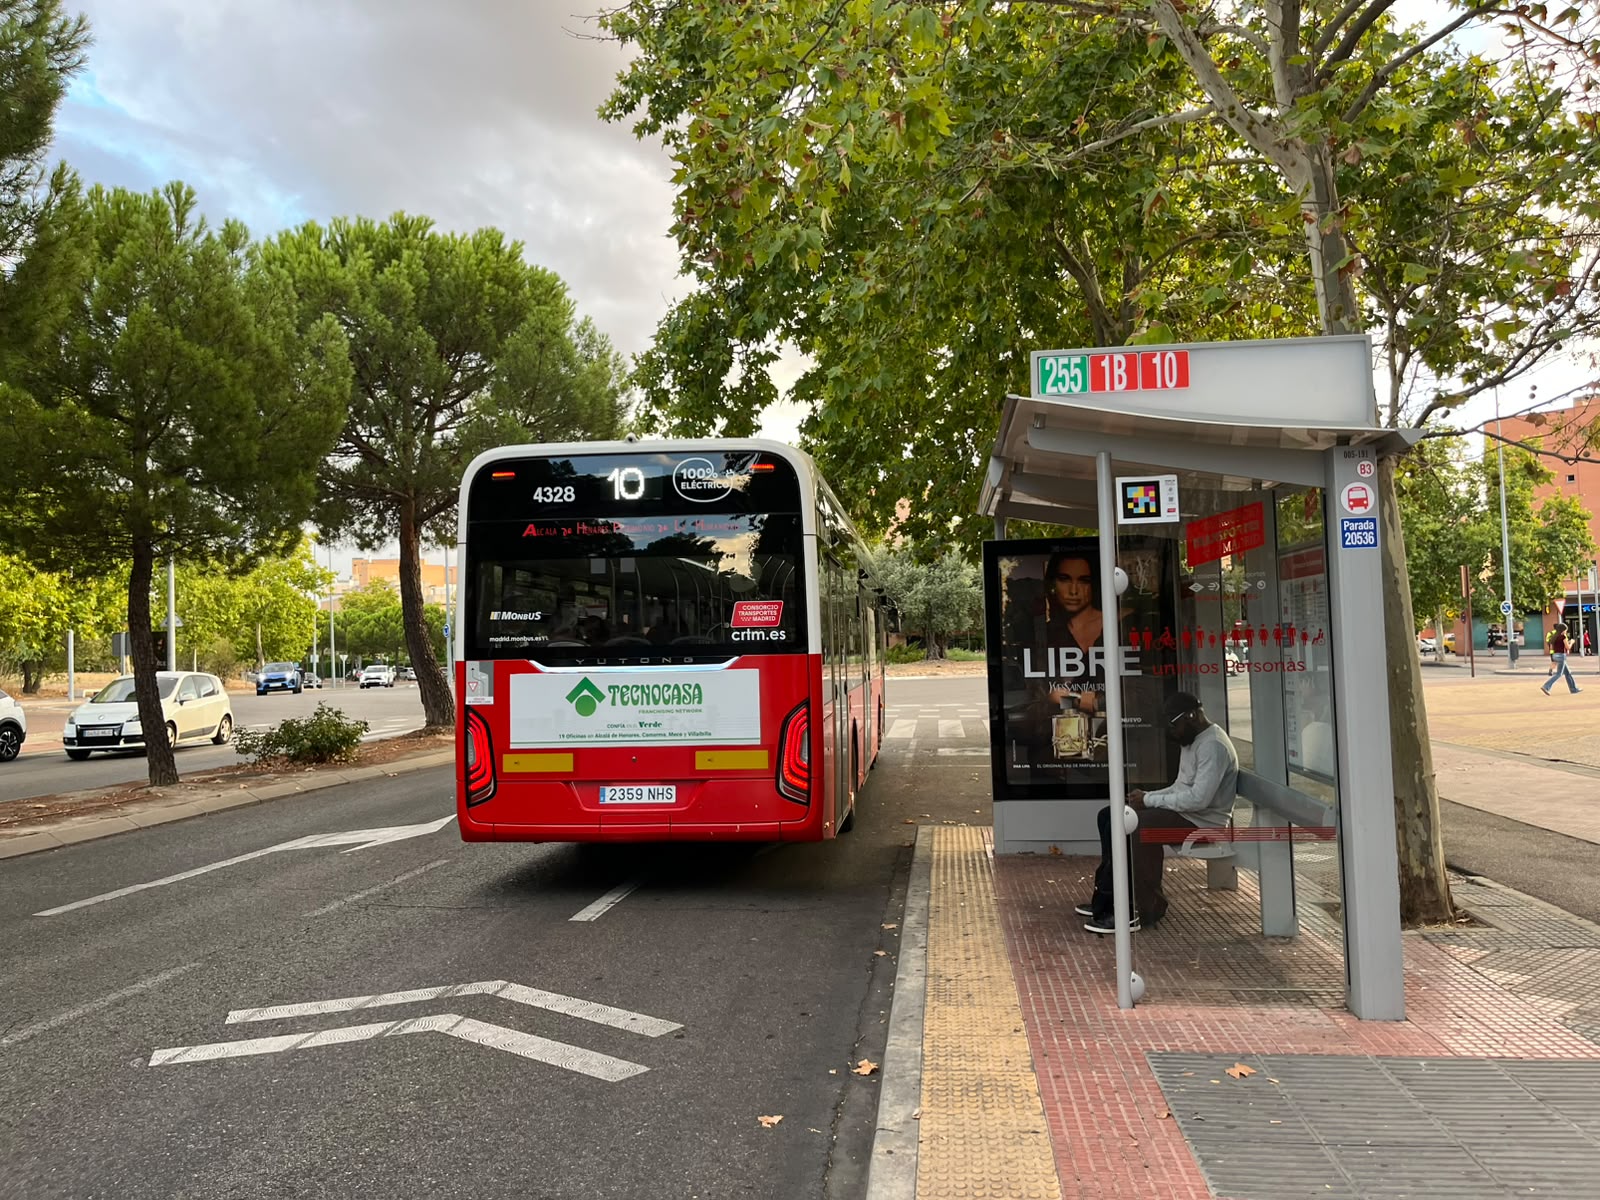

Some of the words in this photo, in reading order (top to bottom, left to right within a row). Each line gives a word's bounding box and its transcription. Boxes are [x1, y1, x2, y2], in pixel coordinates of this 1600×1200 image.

[1045, 357, 1082, 394] 255
[1101, 354, 1127, 391] 1B
[1152, 352, 1178, 388] 10
[681, 467, 718, 480] 100%
[1360, 463, 1372, 475] B3
[606, 467, 645, 500] 10
[681, 478, 729, 490] ELÉCTRICO
[533, 486, 576, 503] 4328
[1344, 520, 1375, 531] Parada
[1345, 531, 1375, 546] 20536
[731, 628, 786, 641] crtm.es
[575, 657, 693, 665] YUTONG
[1024, 646, 1142, 678] LIBRE
[1153, 662, 1219, 676] unimos
[608, 683, 702, 706] TECNOCASA
[609, 787, 643, 801] 2359
[648, 787, 673, 800] NHS
